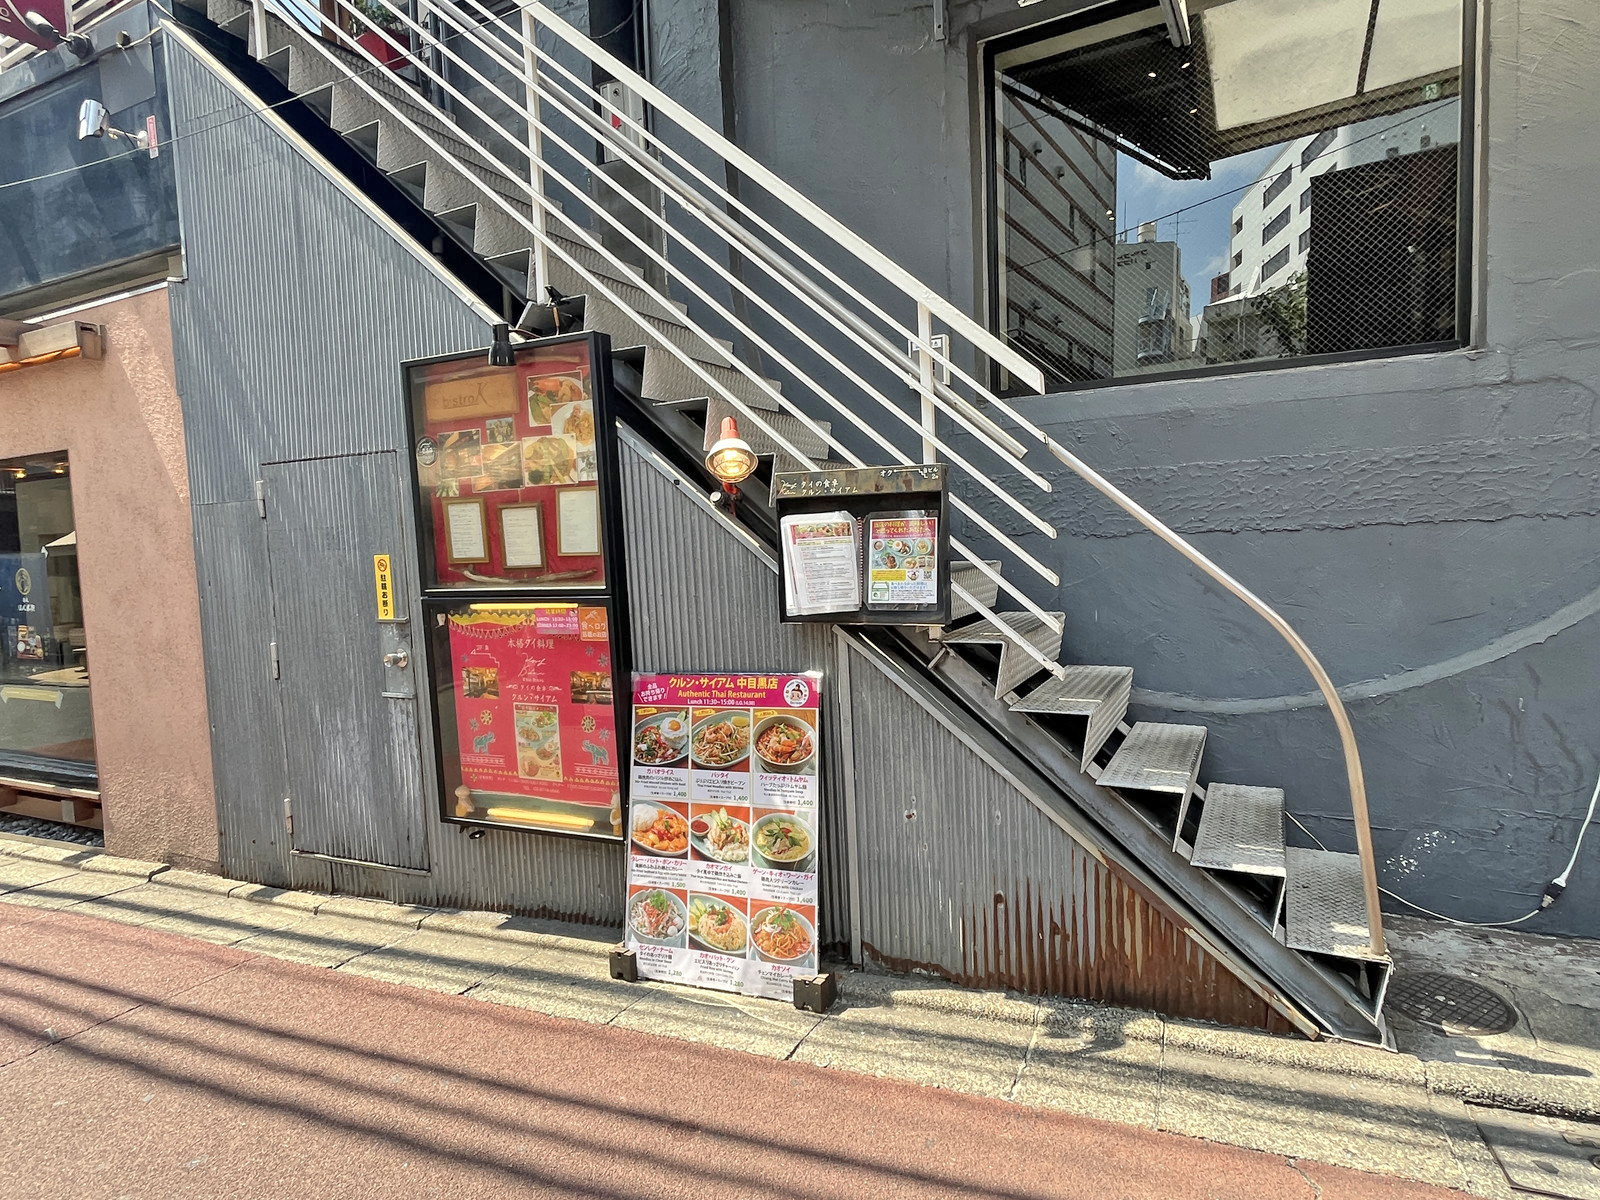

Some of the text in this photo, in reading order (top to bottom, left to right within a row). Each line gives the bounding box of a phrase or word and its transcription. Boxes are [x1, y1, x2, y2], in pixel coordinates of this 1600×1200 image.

[802, 486, 858, 496] クルン・サイアム
[508, 638, 555, 650] 本格タイ料理
[669, 677, 734, 689] クルン・サイアム
[736, 677, 778, 689] 中目黒店
[677, 690, 766, 699] Authentic Thai Restaurant
[705, 863, 733, 871] カオマンガイ
[731, 888, 746, 896] 1,400
[796, 896, 813, 904] 1,400
[668, 969, 683, 977] 1,280
[771, 964, 791, 973] カオソイ
[729, 979, 744, 988] 1,280
